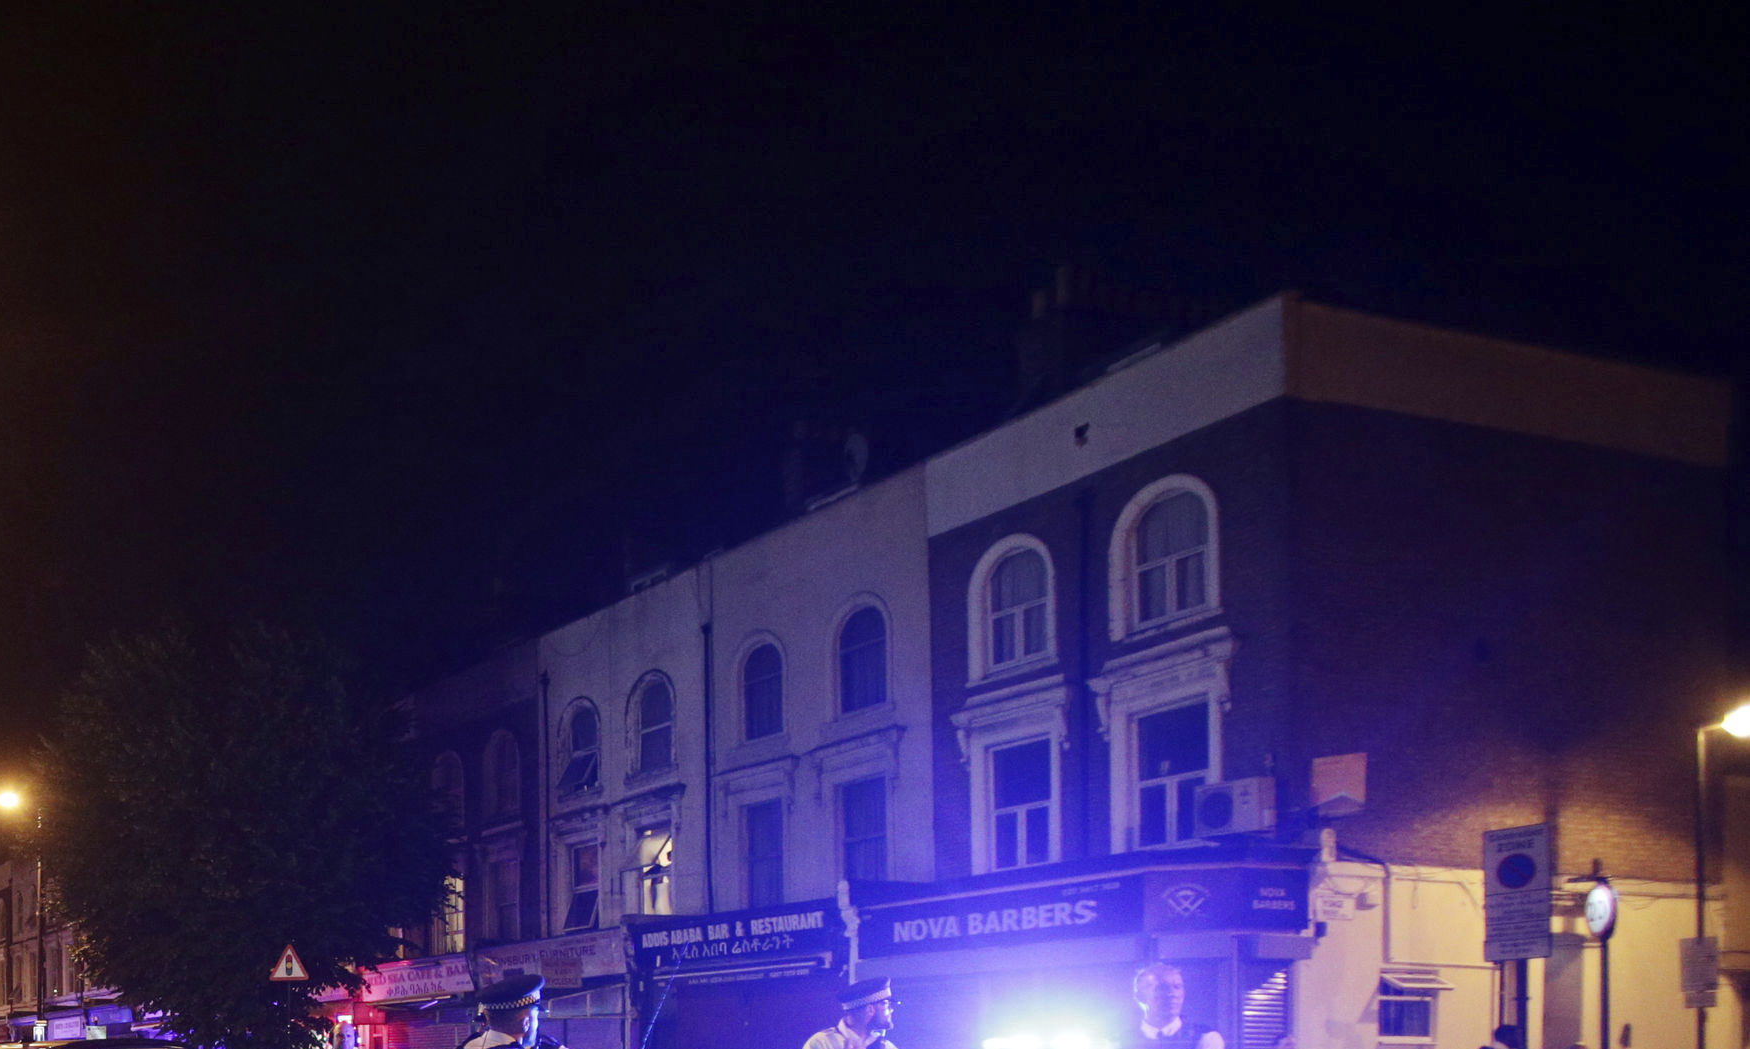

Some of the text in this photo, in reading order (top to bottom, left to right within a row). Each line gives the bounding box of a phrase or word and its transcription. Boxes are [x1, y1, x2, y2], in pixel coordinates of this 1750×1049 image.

[642, 910, 825, 949] ADDIS ABABA BAR & RESTAURANT
[893, 899, 1099, 943] NOVA BARBERS
